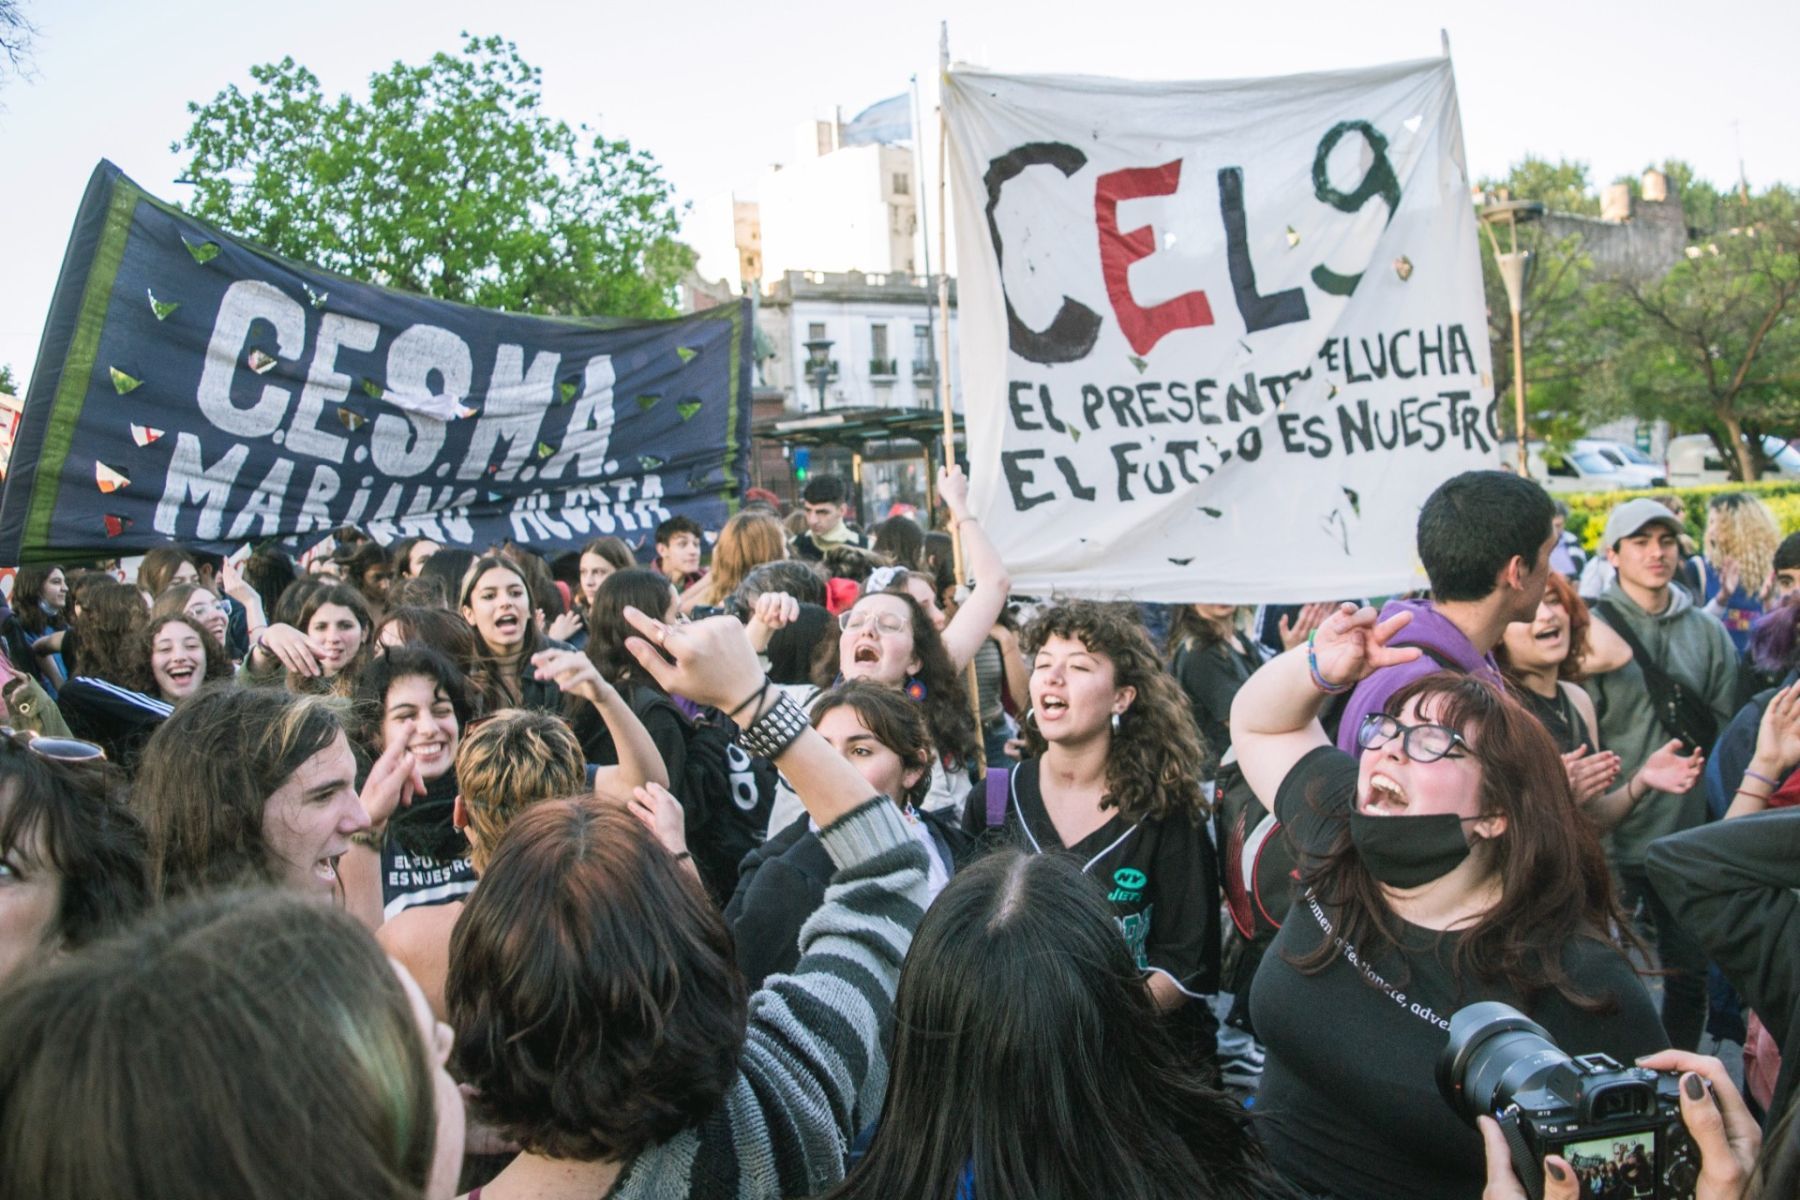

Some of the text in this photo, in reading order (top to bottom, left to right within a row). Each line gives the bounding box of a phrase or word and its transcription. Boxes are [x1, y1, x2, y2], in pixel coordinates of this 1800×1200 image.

[1008, 380, 1066, 434] EL
[1342, 323, 1477, 385] LUCHA
[1000, 448, 1097, 513] EL
[1110, 426, 1263, 502] FUTO
[1277, 410, 1333, 459] ES
[389, 856, 473, 886] ES NUESRO
[394, 854, 412, 870] EL
[1410, 1002, 1451, 1032] adve
